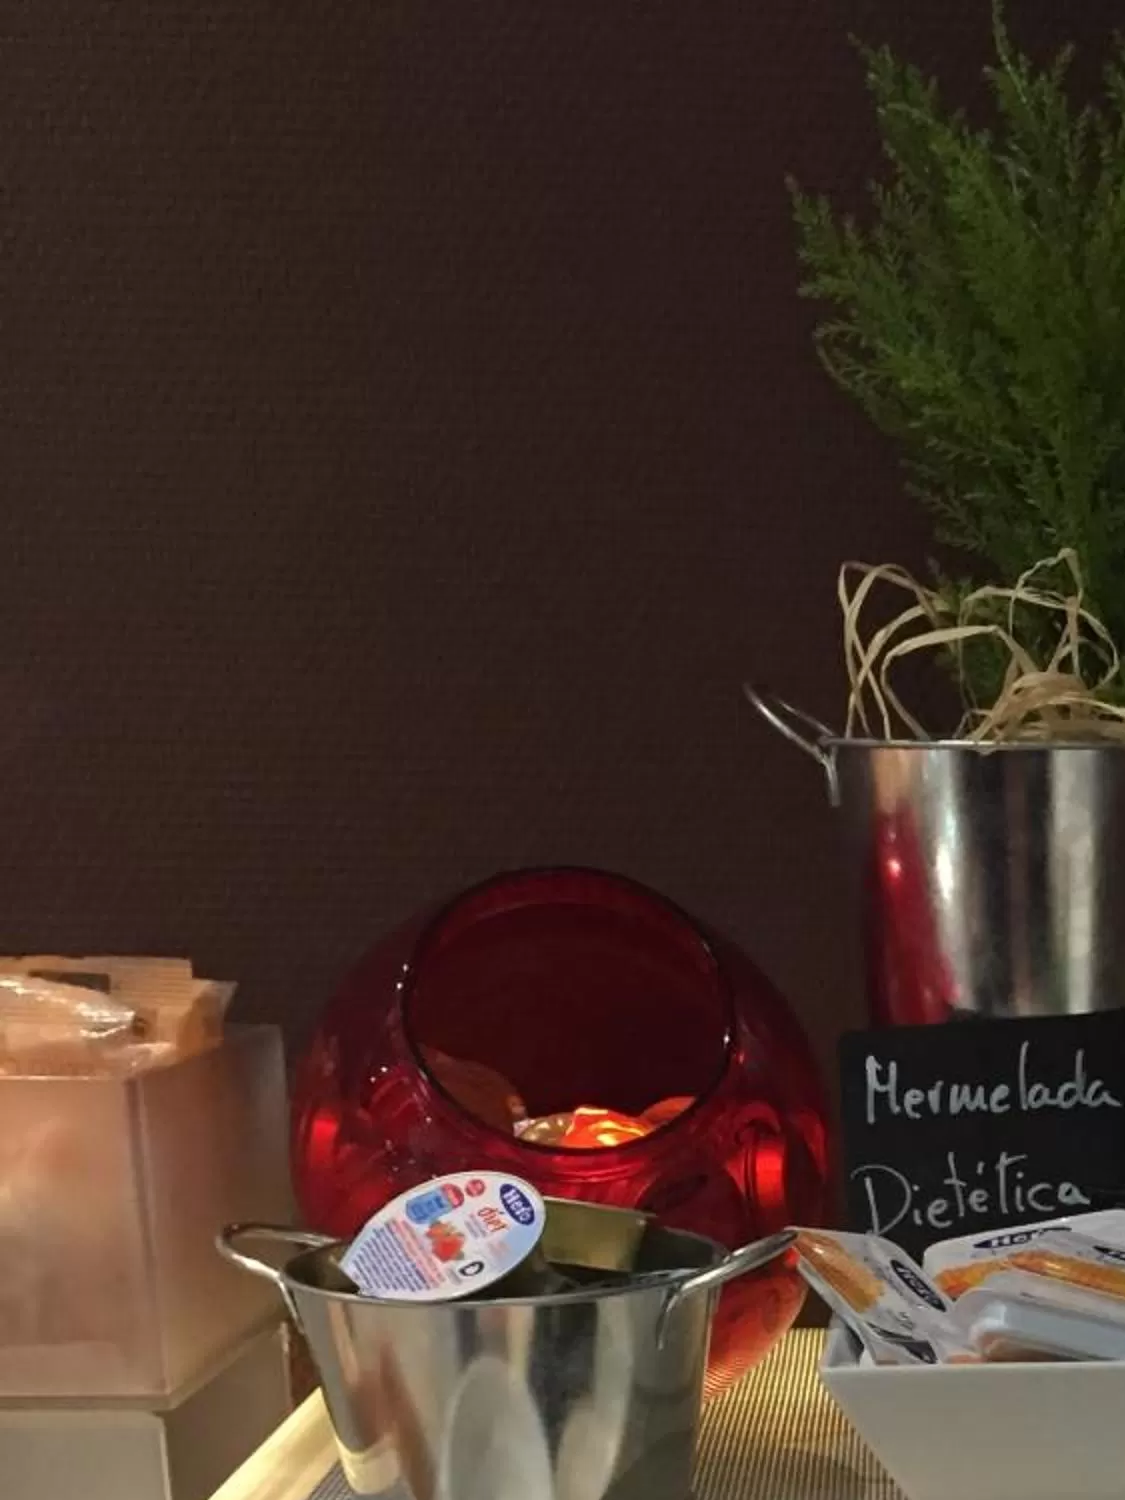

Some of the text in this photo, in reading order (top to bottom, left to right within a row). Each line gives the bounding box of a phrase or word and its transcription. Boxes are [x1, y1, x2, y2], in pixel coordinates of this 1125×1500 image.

[865, 1040, 1122, 1124] Mermelada
[503, 1188, 531, 1221] Hero
[850, 1152, 1090, 1235] Dietética
